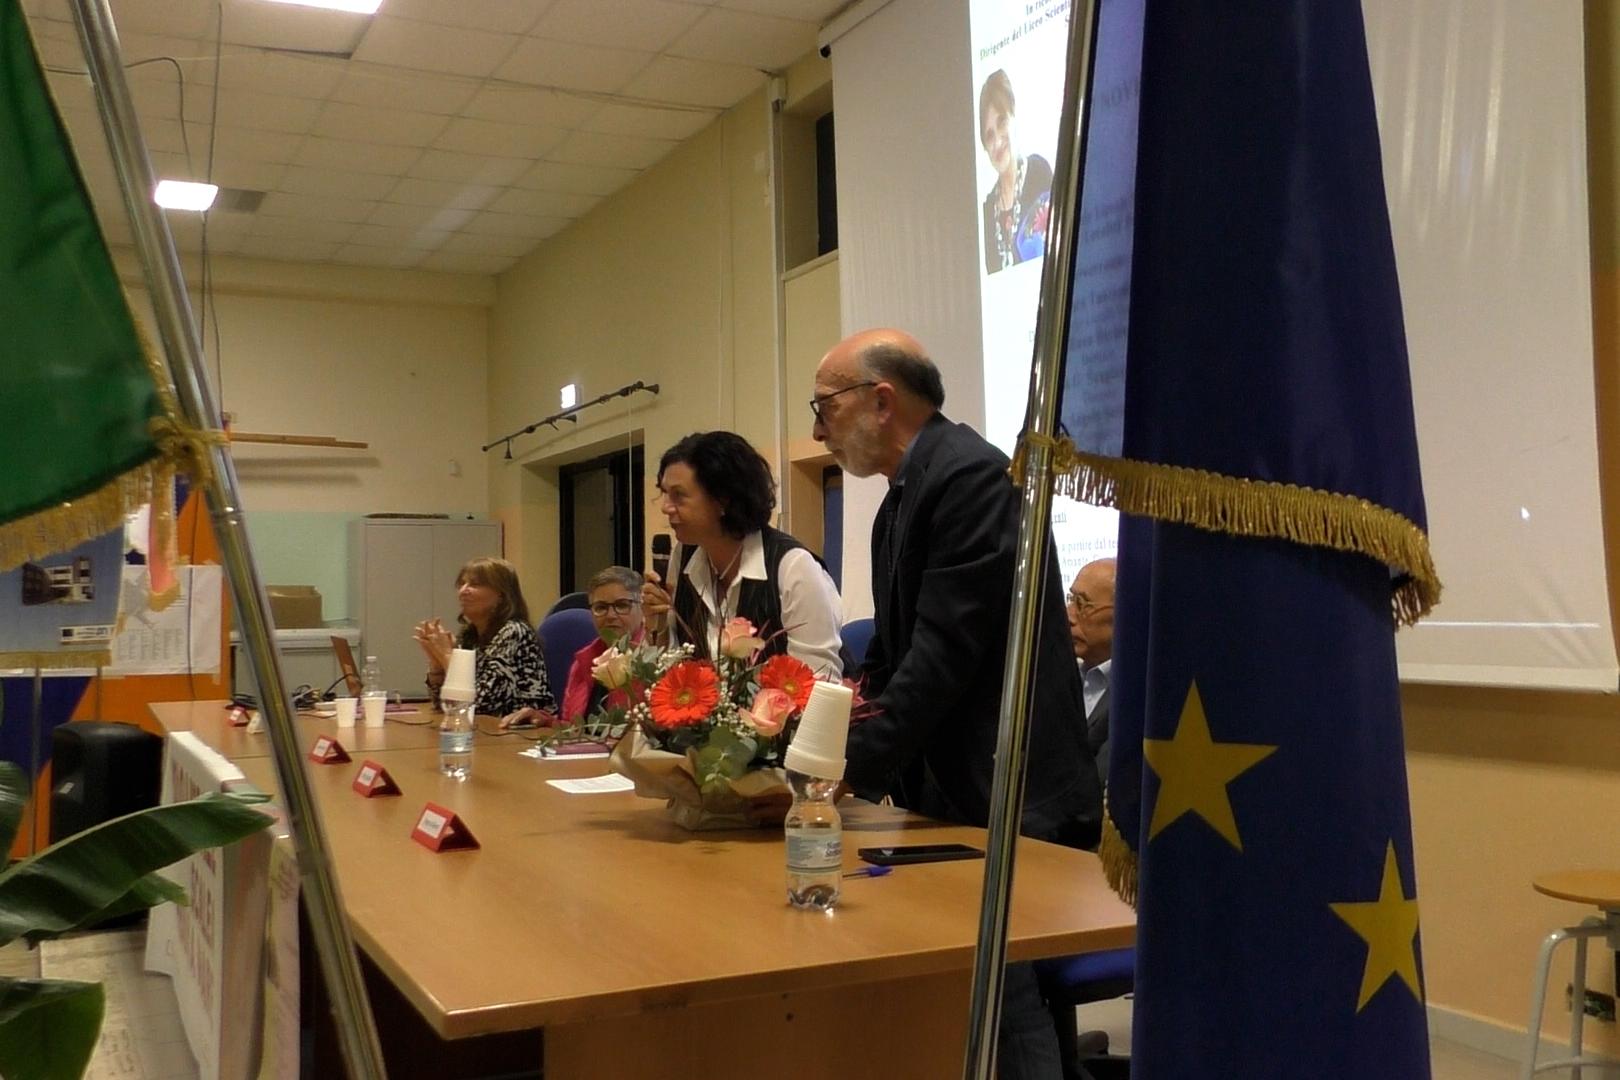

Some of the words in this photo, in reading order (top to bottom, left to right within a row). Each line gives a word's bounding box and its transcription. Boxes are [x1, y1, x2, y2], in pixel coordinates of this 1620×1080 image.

[980, 36, 1010, 60] Dirigente
[1011, 26, 1022, 42] del
[1024, 17, 1043, 34] Liceo
